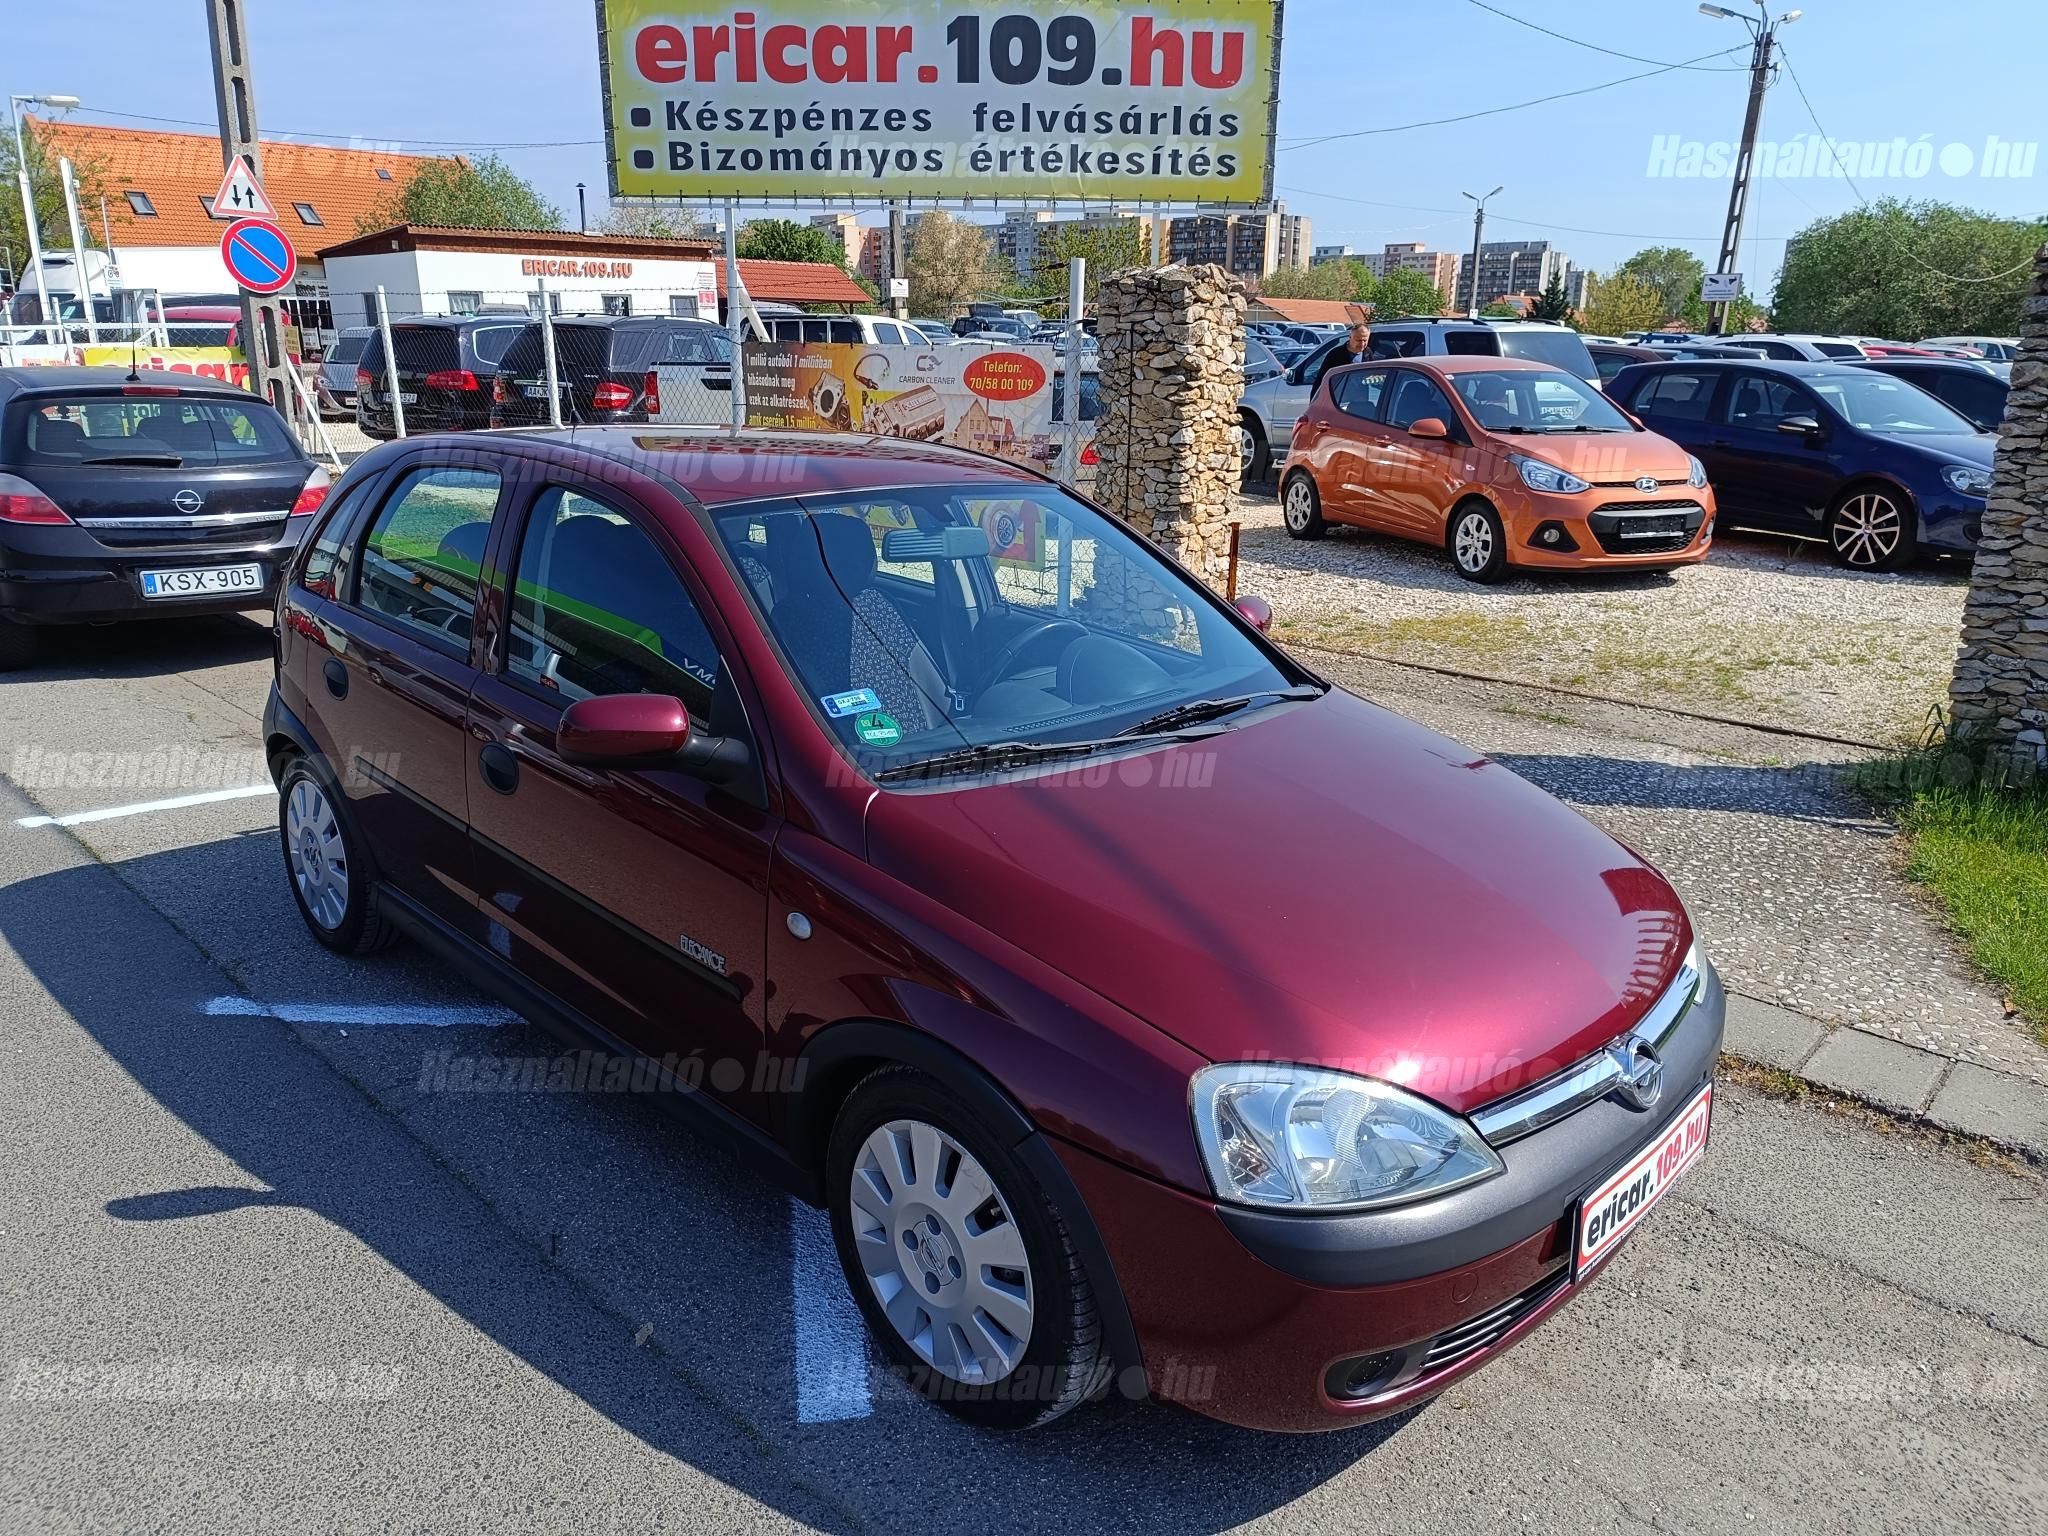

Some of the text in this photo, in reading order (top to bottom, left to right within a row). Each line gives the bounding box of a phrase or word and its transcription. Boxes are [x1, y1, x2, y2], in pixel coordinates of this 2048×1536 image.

[635, 12, 1245, 89] ericar.109.hu
[665, 100, 1239, 137] Készpénzes felvásárlás
[669, 140, 1238, 178] Bizományos értékesítés
[522, 258, 633, 279] ERICAR.109.HU
[750, 352, 767, 367] millió
[768, 354, 793, 369] autóból
[799, 354, 832, 369] millióban
[983, 360, 1023, 374] Telefon:
[747, 372, 796, 391] hibásodnak meg
[898, 375, 956, 385] CARBON CLEANER
[970, 377, 1034, 391] 70/58 00 109
[749, 393, 810, 411] ezek az alkatrészek,
[160, 568, 255, 593] KSX-905
[871, 714, 884, 729] 4
[1586, 1110, 1705, 1249] ericar.109.hu
